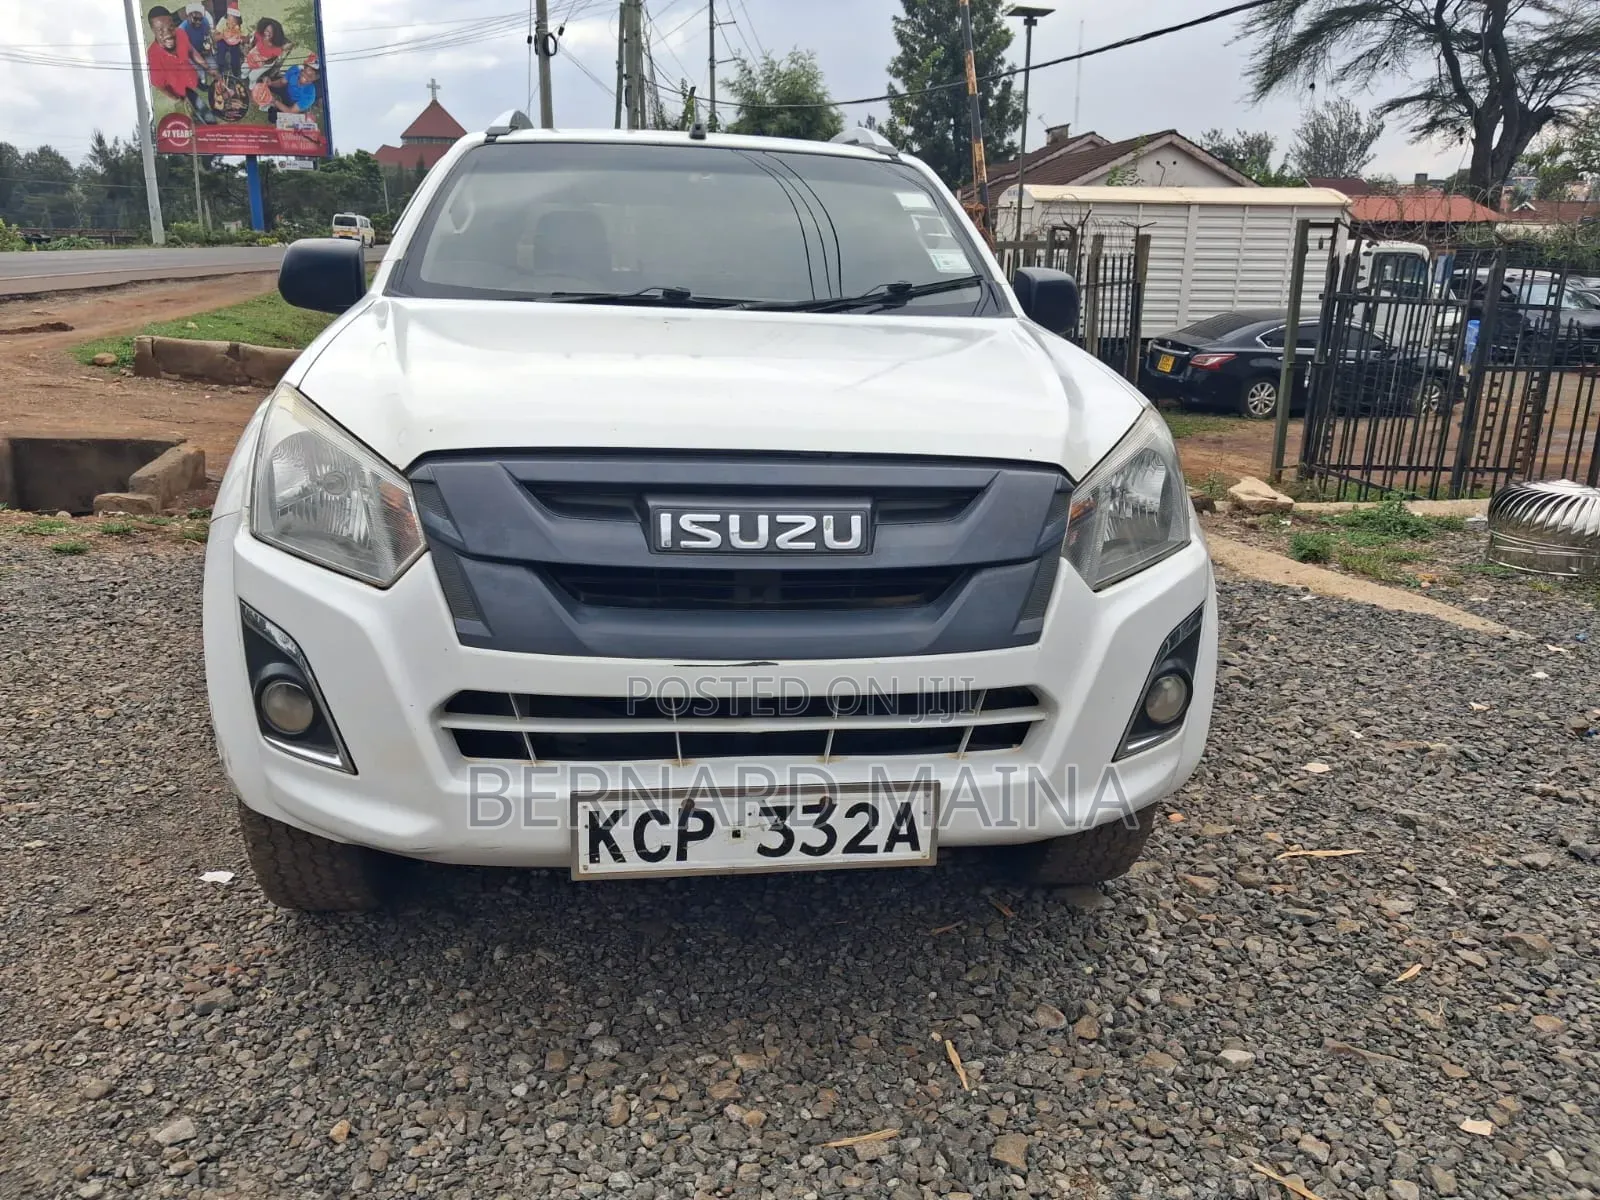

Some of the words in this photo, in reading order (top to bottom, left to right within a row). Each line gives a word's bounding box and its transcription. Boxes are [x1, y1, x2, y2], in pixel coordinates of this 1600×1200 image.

[660, 513, 862, 550] ISUZU
[588, 808, 715, 864] KCP
[757, 801, 921, 858] 332A
